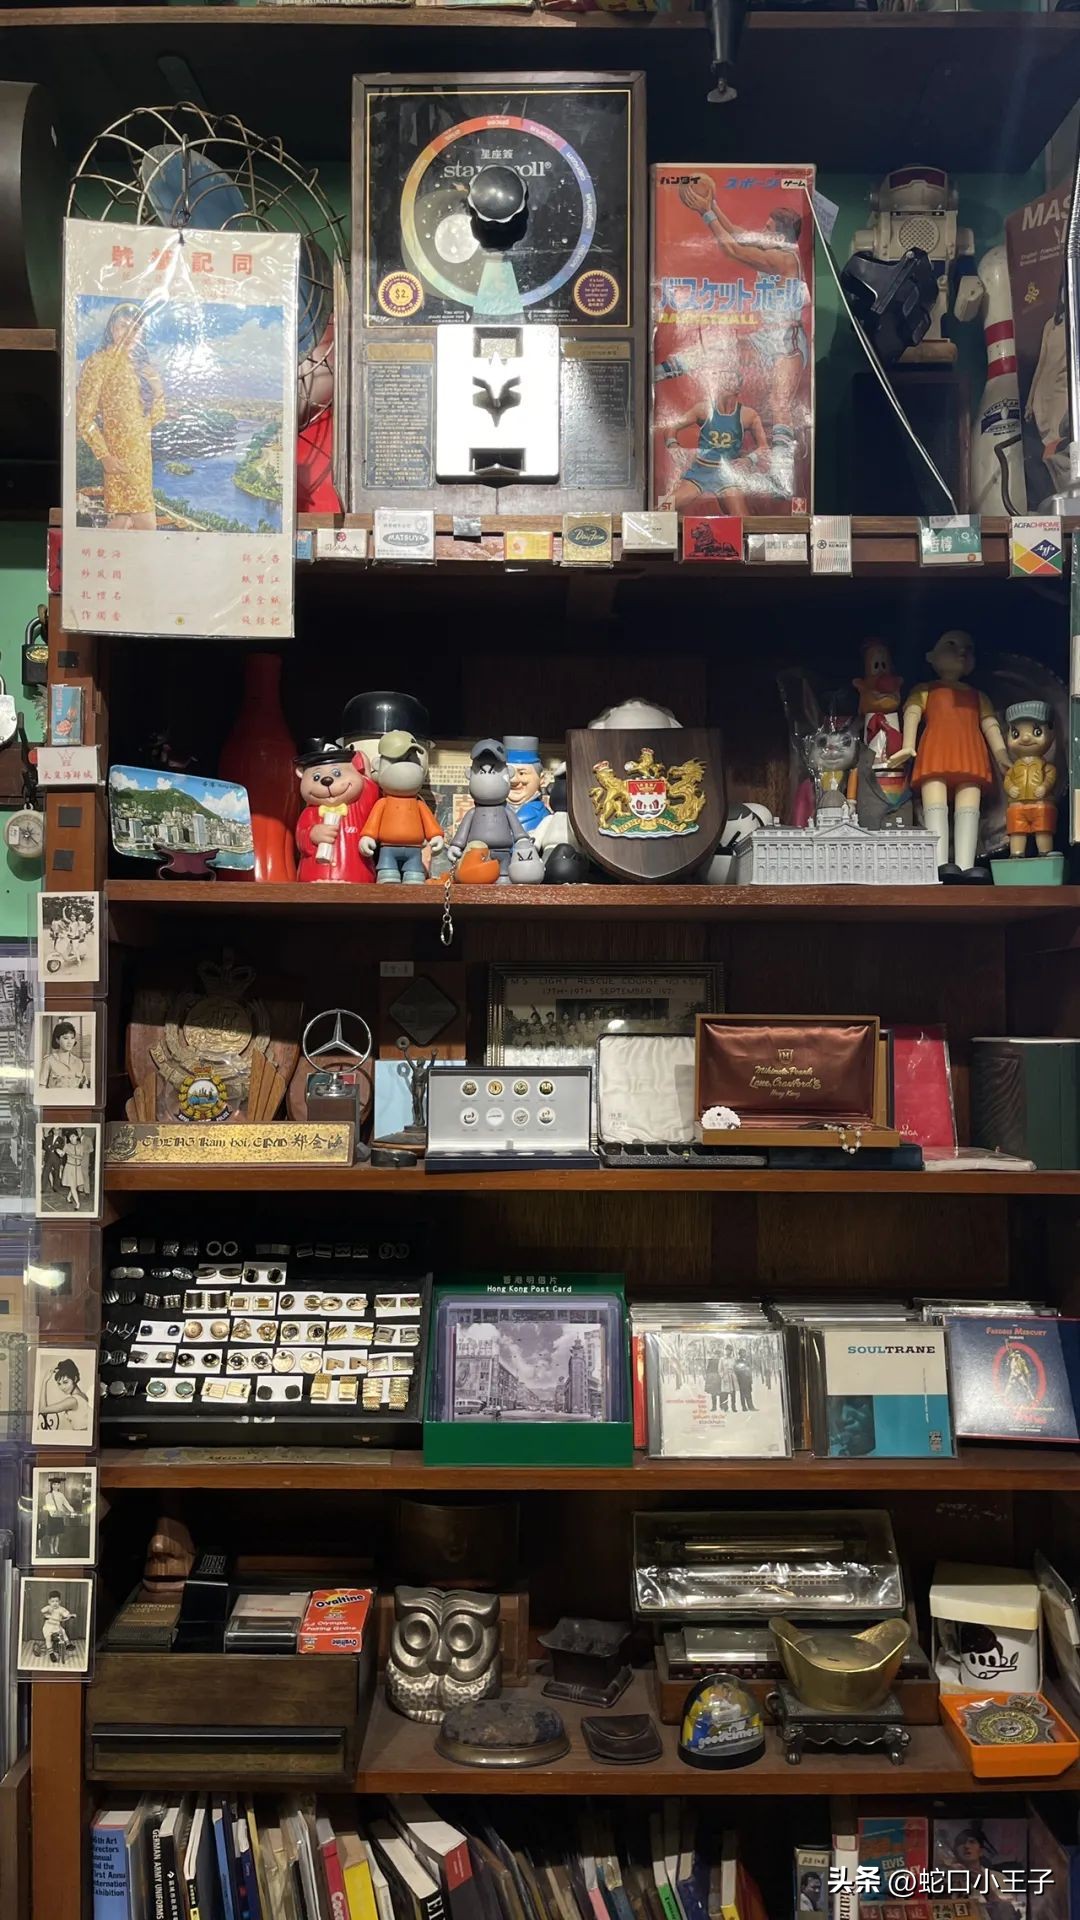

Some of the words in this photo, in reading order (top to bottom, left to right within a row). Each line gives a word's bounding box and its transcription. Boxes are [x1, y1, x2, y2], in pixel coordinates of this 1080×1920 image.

[658, 275, 806, 311] バスケットボール
[708, 430, 732, 449] 32
[1014, 521, 1060, 529] AGFACHROME
[387, 533, 426, 542] MATSUYA
[1037, 545, 1056, 557] Agfa
[487, 1284, 506, 1293] Hong
[508, 1285, 528, 1293] Kong
[530, 1285, 549, 1293] Post
[552, 1285, 572, 1293] Card
[847, 1346, 936, 1354] SOULTRANE
[316, 1594, 366, 1609] Ovaltine
[698, 1727, 759, 1750] goodtimes
[106, 1836, 118, 1844] Art
[152, 1828, 161, 1860] GERMAN
[882, 1857, 905, 1870] ELVIS
[153, 1862, 163, 1882] ARMY
[154, 1884, 165, 1920] UNIFORMS
